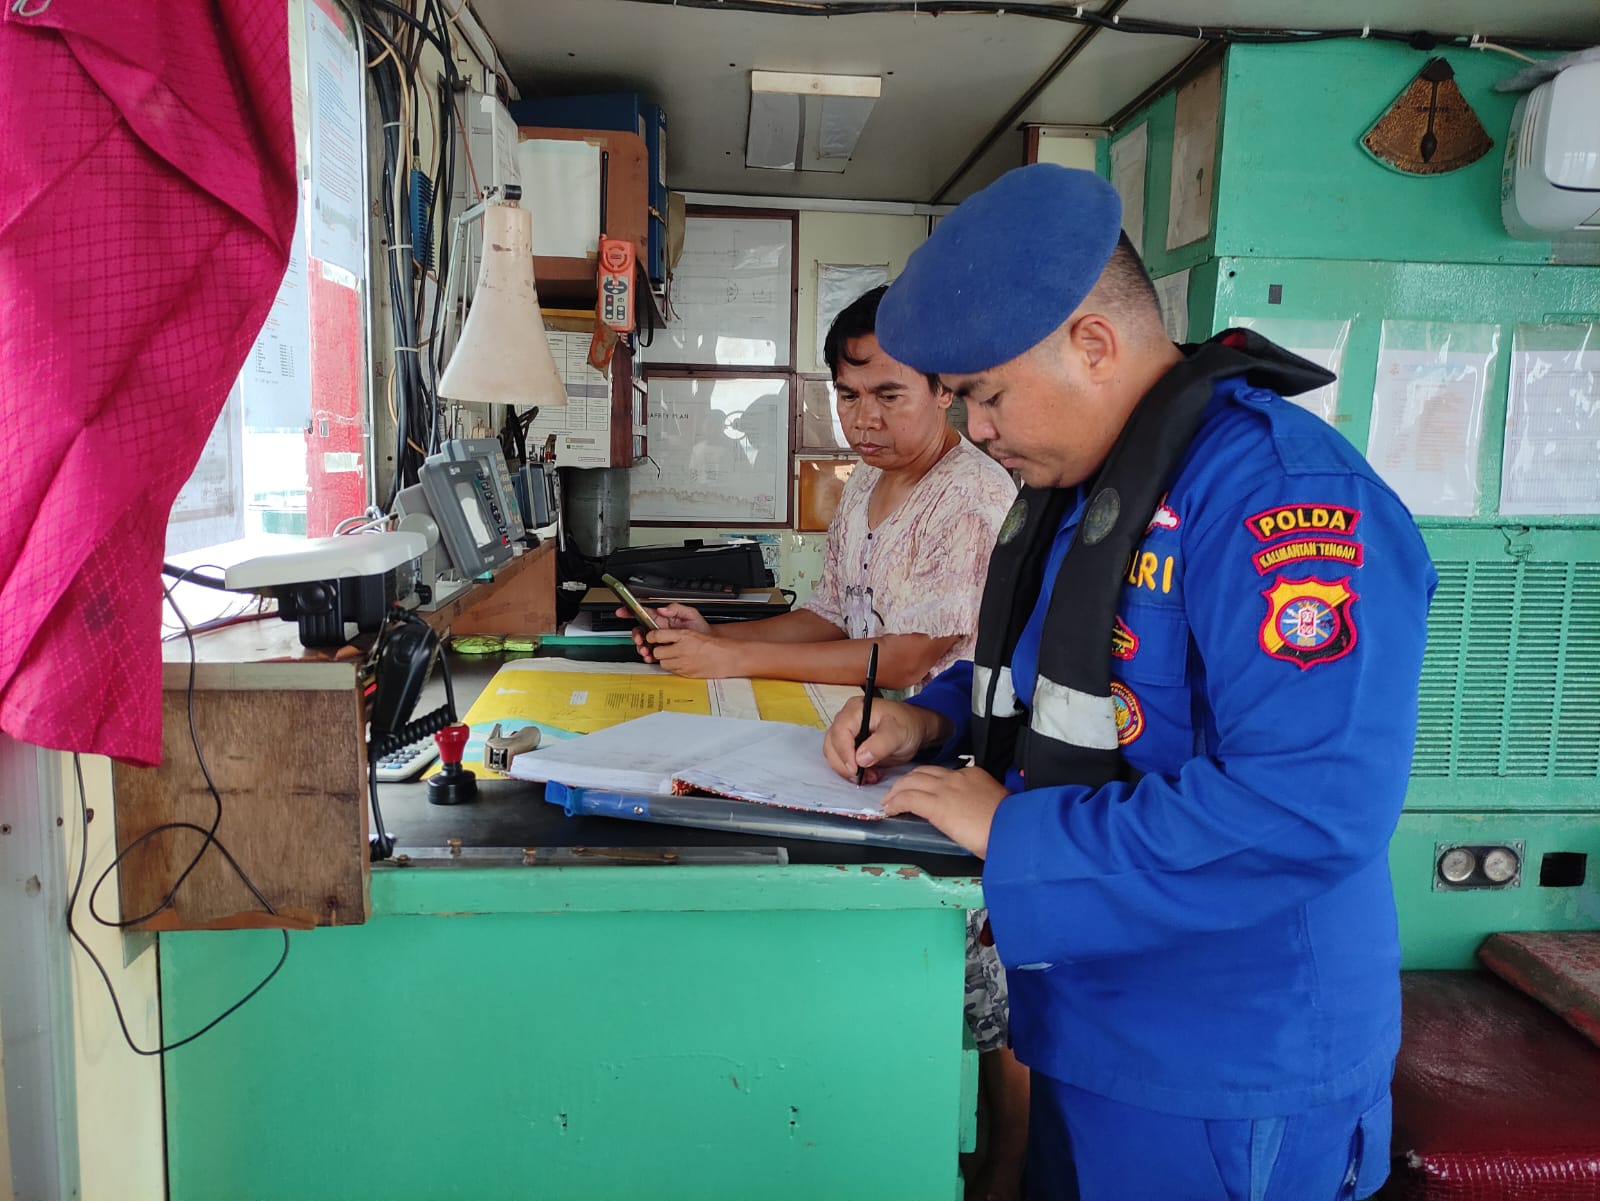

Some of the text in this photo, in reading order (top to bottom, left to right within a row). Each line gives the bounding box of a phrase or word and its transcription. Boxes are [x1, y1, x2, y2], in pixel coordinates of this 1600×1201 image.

[1259, 508, 1346, 537] POLDA
[1259, 542, 1356, 568] KALIMANTAN TENGAH
[1123, 549, 1174, 594] LRI
